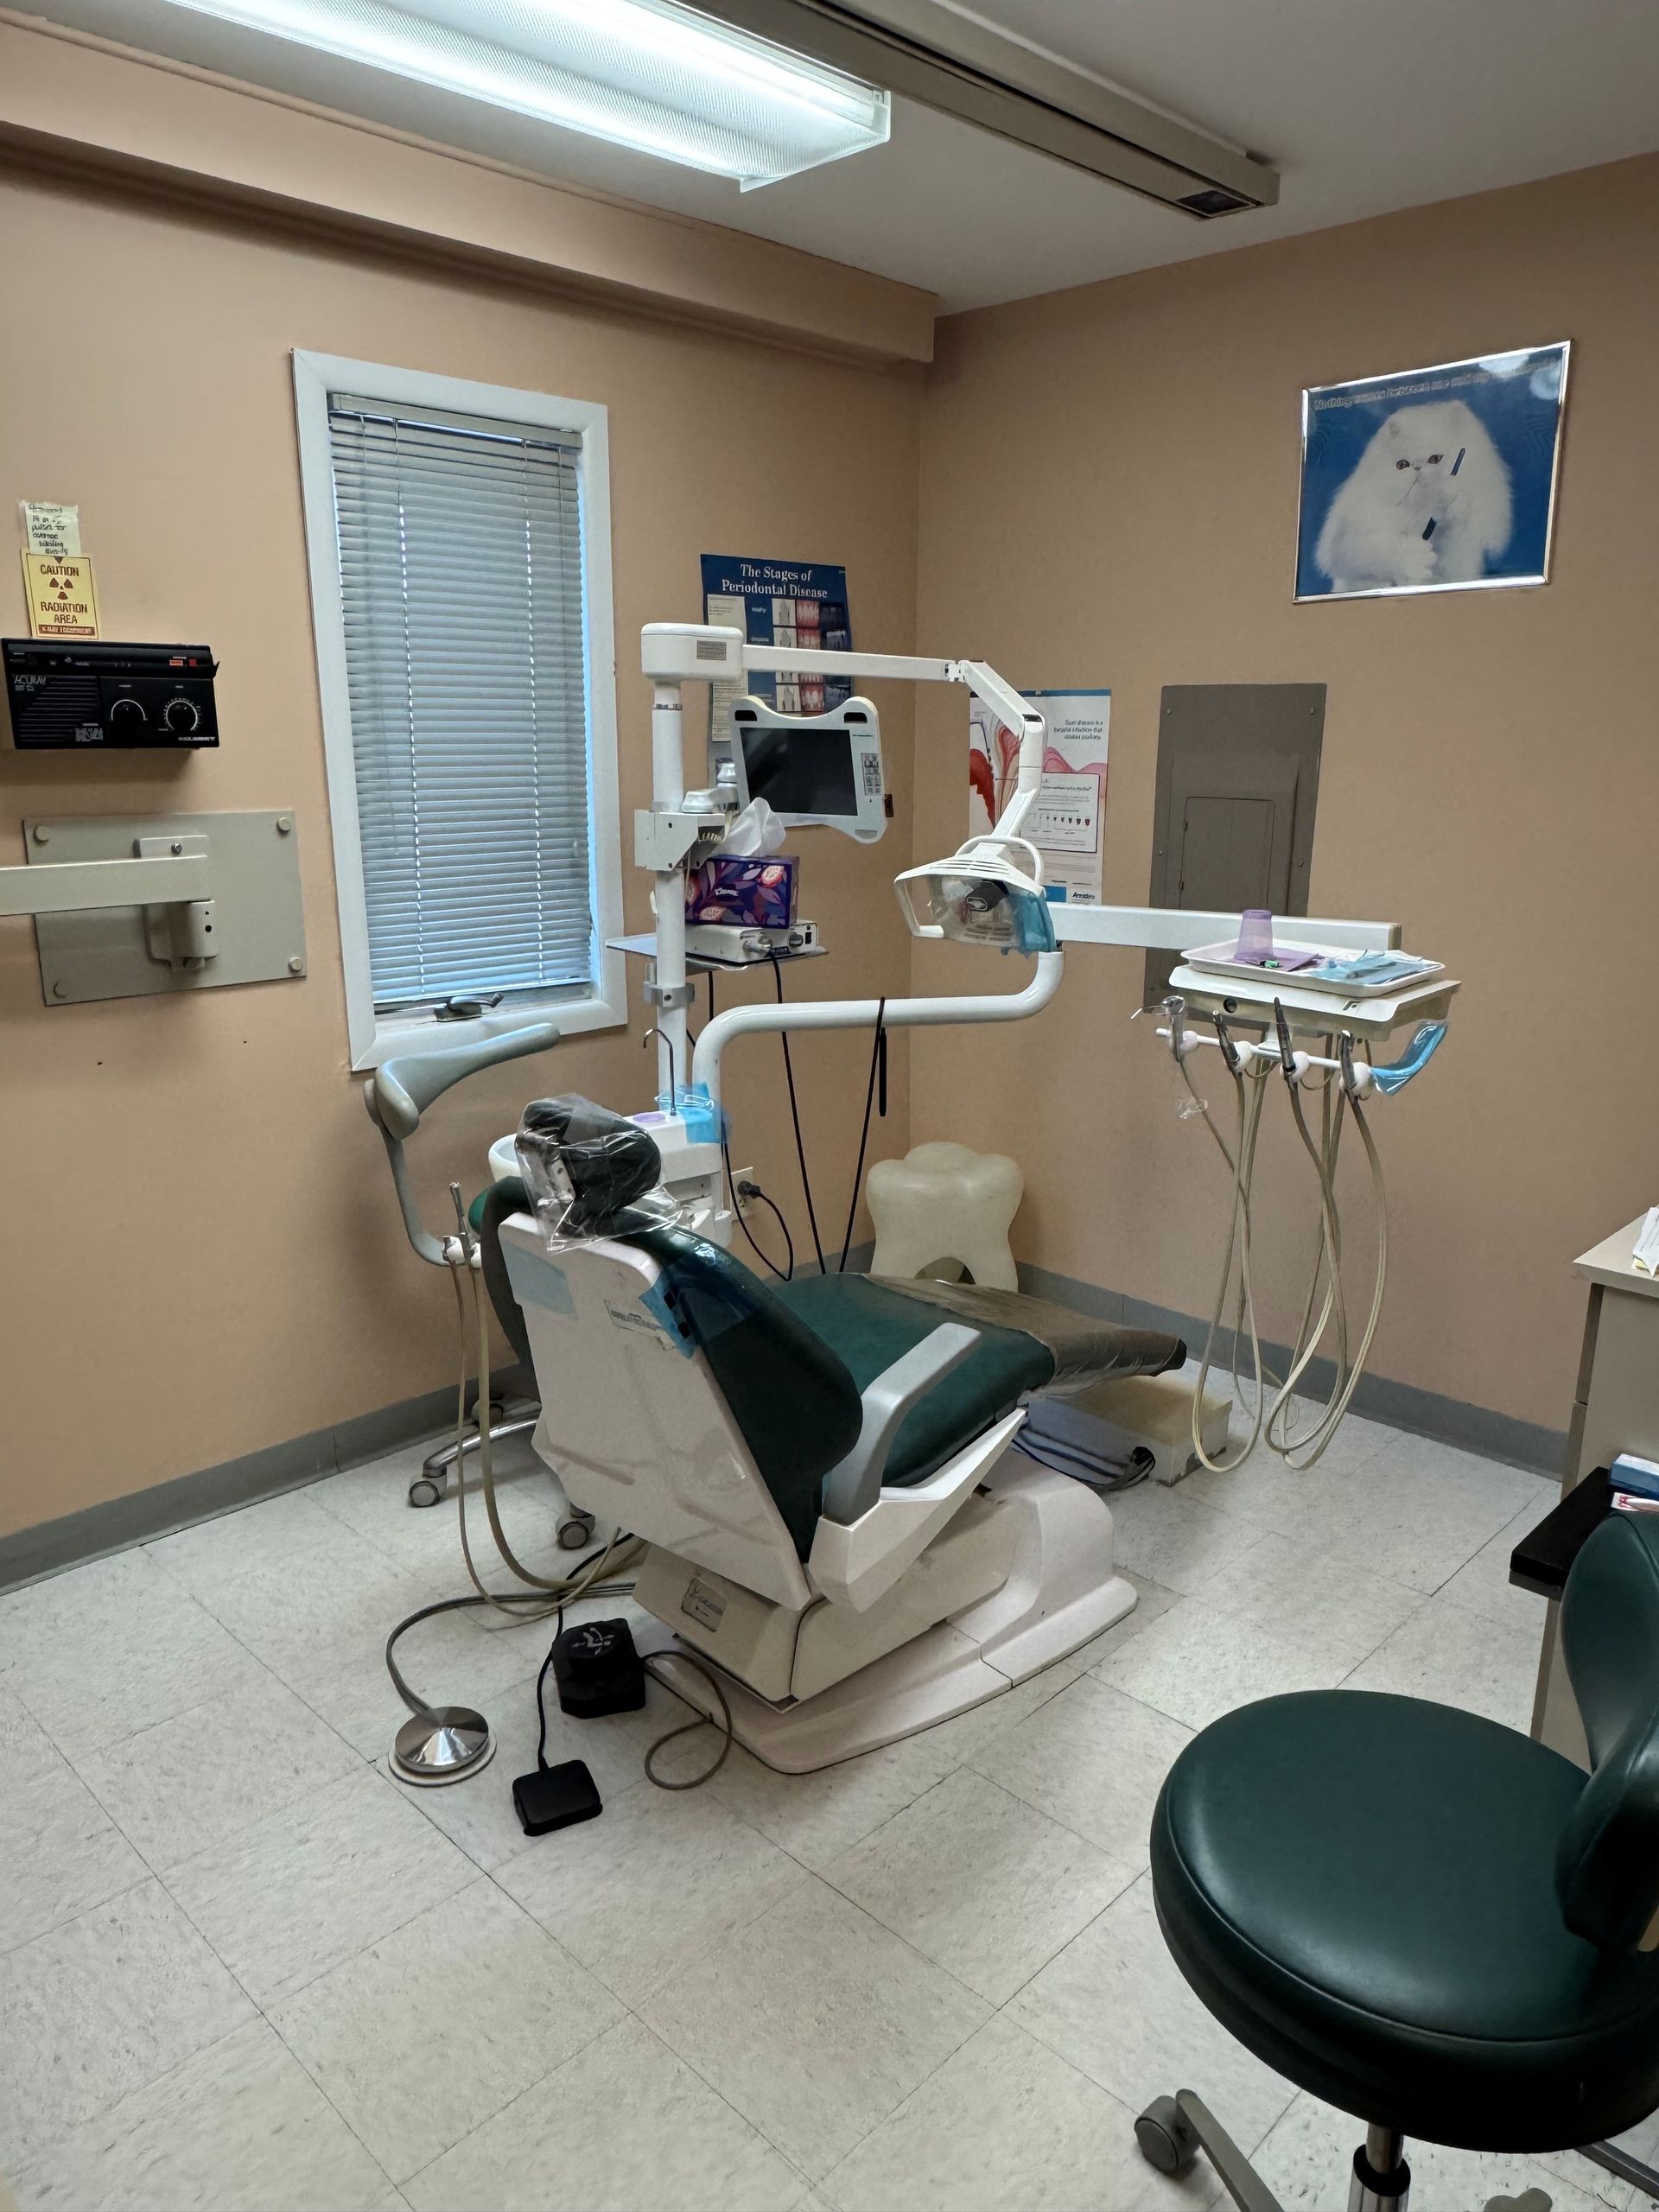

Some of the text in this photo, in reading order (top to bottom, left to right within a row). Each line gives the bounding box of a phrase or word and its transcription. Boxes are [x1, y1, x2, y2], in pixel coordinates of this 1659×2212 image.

[40, 564, 79, 577] CAUTION
[740, 563, 812, 582] The Stages of
[721, 578, 828, 599] Periodontal Disease
[40, 601, 88, 613] RADIATION
[54, 614, 78, 624] AREA
